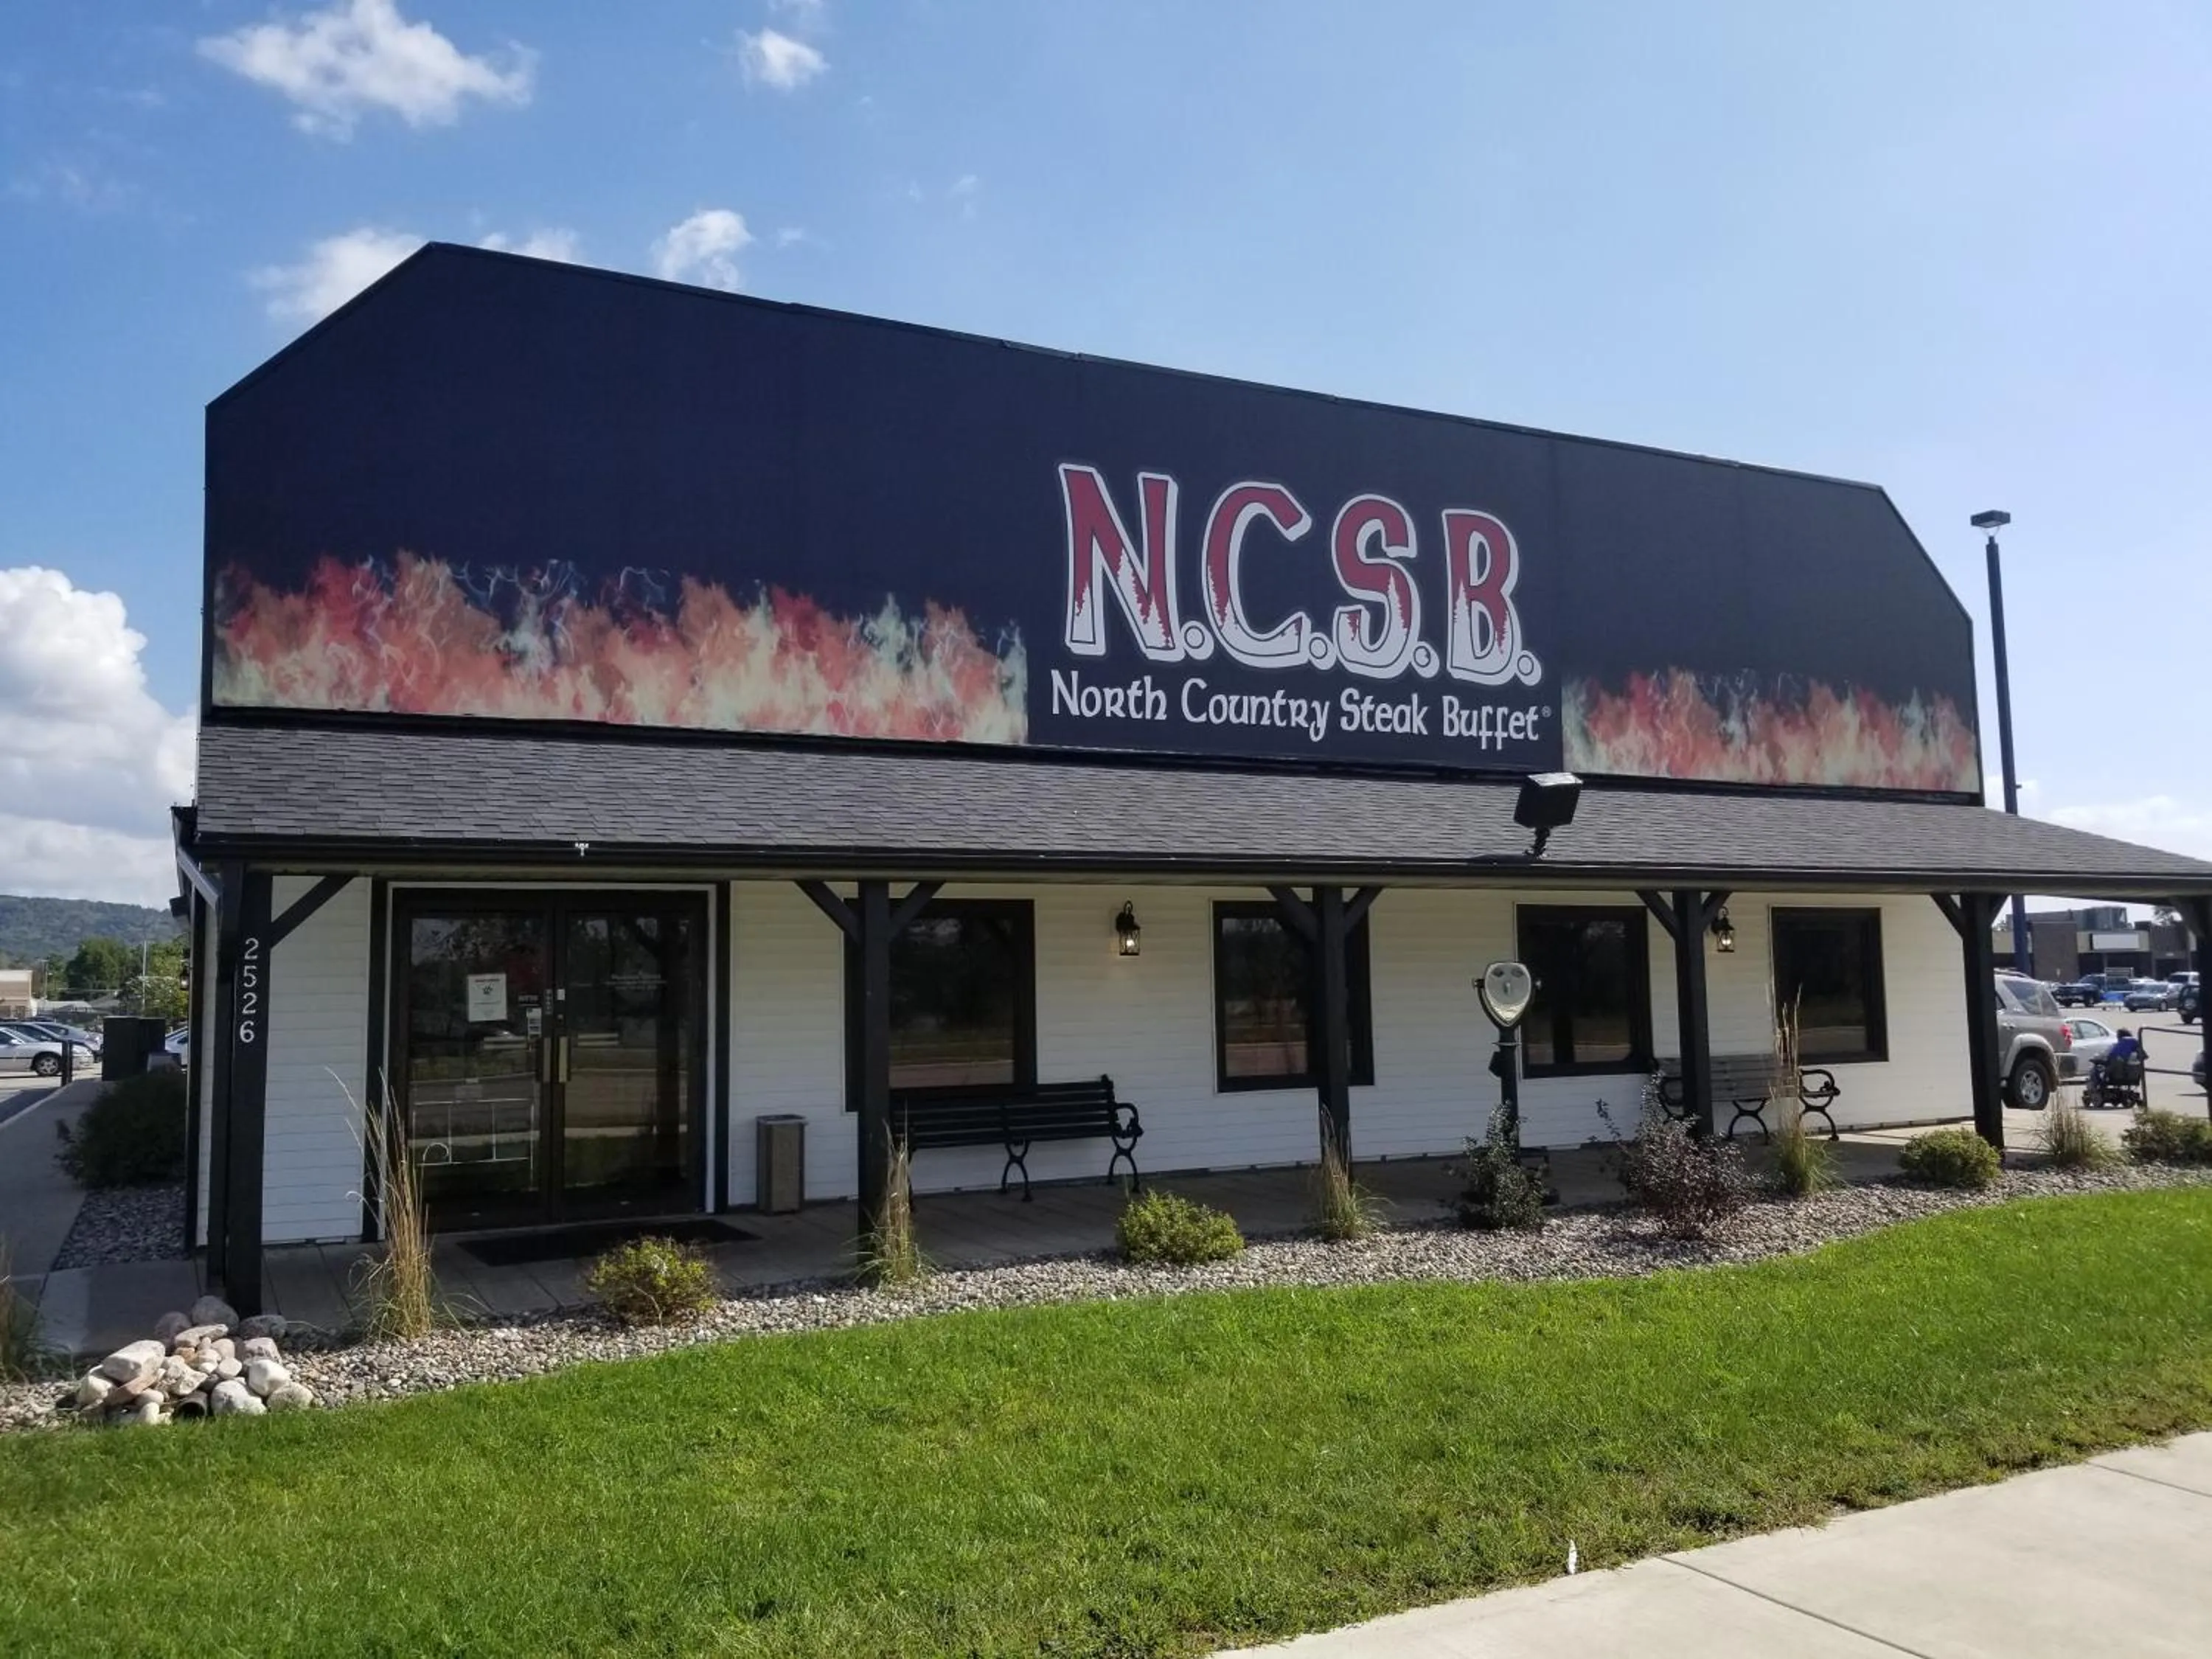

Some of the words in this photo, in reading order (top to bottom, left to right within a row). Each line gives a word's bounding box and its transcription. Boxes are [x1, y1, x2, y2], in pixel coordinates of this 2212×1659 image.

[1058, 463, 1542, 686] N.C.S.B.
[1051, 669, 1167, 721] North
[1180, 678, 1330, 742] Country
[1340, 687, 1428, 736] Steak
[240, 937, 259, 1043] 2526
